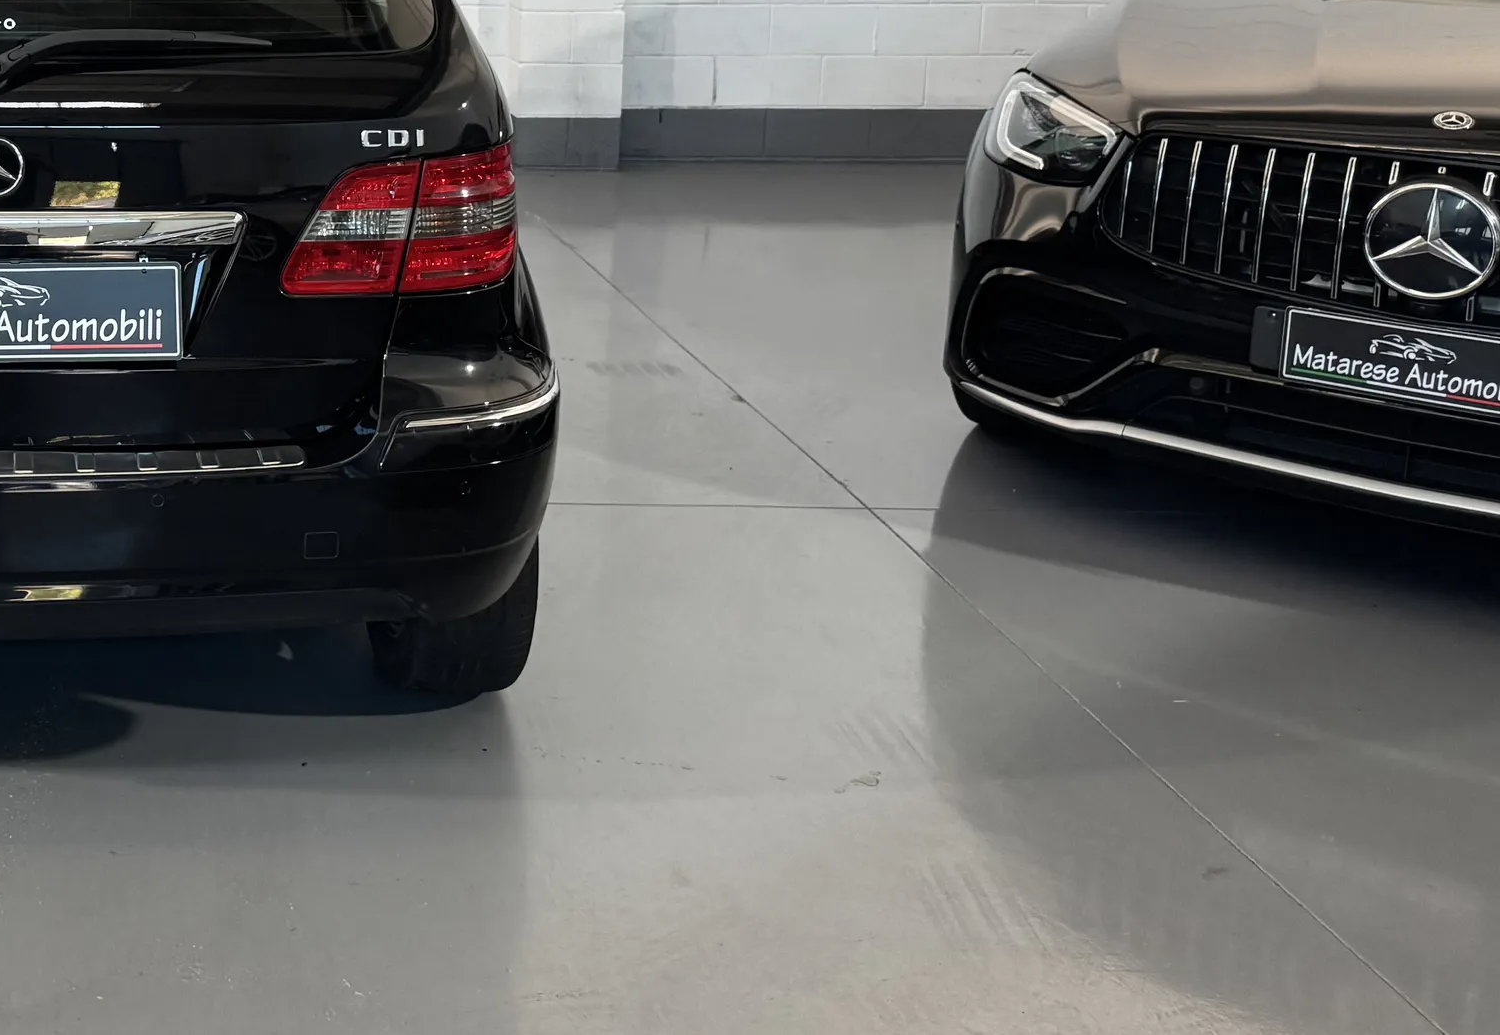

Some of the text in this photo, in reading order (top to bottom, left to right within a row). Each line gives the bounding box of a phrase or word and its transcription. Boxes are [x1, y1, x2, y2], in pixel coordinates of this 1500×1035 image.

[360, 128, 425, 148] CDI
[1292, 343, 1500, 401] Matarese Automo
